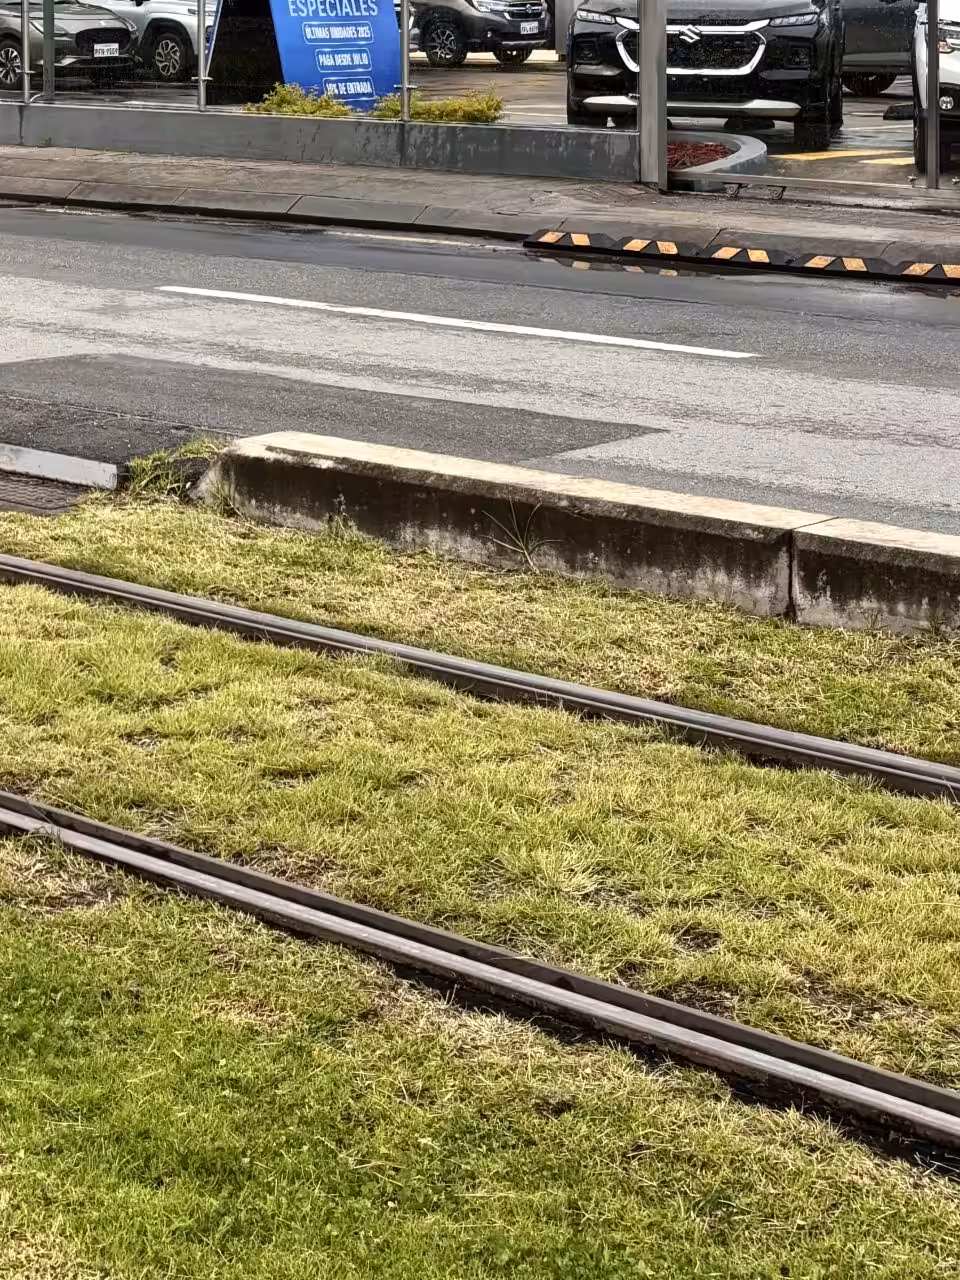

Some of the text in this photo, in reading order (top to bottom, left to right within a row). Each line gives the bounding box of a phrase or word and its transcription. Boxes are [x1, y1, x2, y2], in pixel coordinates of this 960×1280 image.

[318, 54, 334, 66] PAGA
[335, 54, 352, 66] DESDE
[340, 82, 347, 94] DE
[348, 82, 372, 94] ENTRADA
